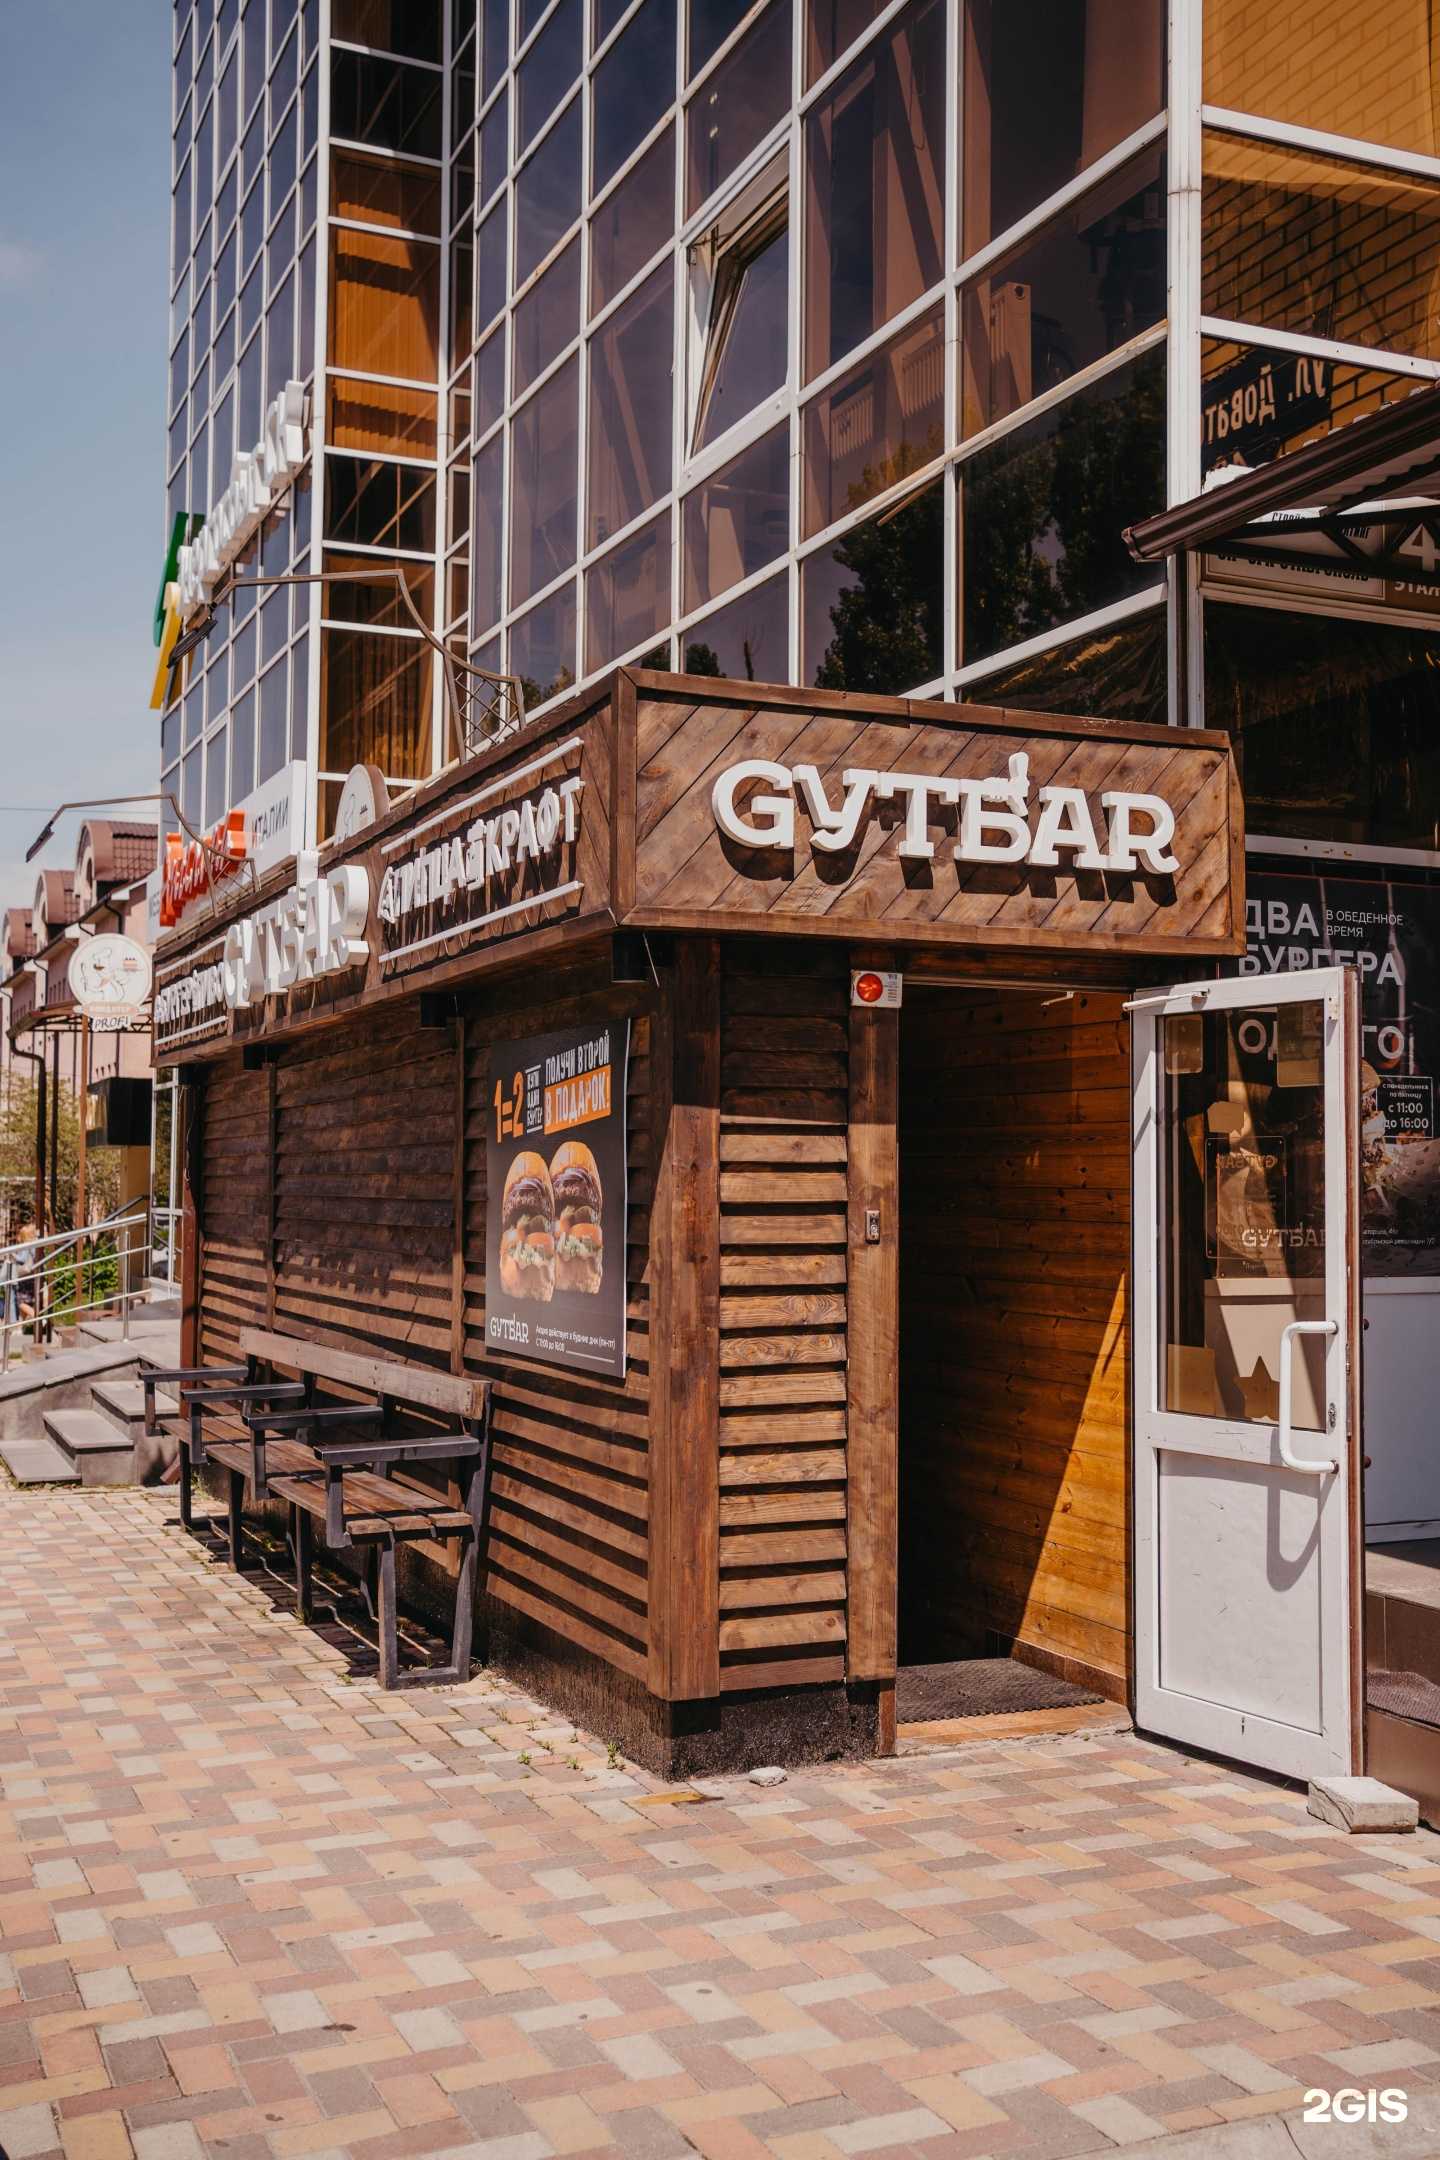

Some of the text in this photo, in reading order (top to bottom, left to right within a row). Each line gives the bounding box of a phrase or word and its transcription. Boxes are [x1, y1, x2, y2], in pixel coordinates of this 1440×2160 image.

[486, 776, 583, 876] КРАФТ
[1245, 899, 1320, 939] ДВА
[1327, 926, 1364, 937] ВРЕМЯ
[1336, 910, 1404, 926] ОБЕДЕННОЕ
[545, 1029, 610, 1086] ПОЛУЧИ ВТОРОЙ
[494, 1071, 524, 1143] 1=2
[1396, 1102, 1423, 1114] 11:00
[1400, 1117, 1429, 1129] 16:00
